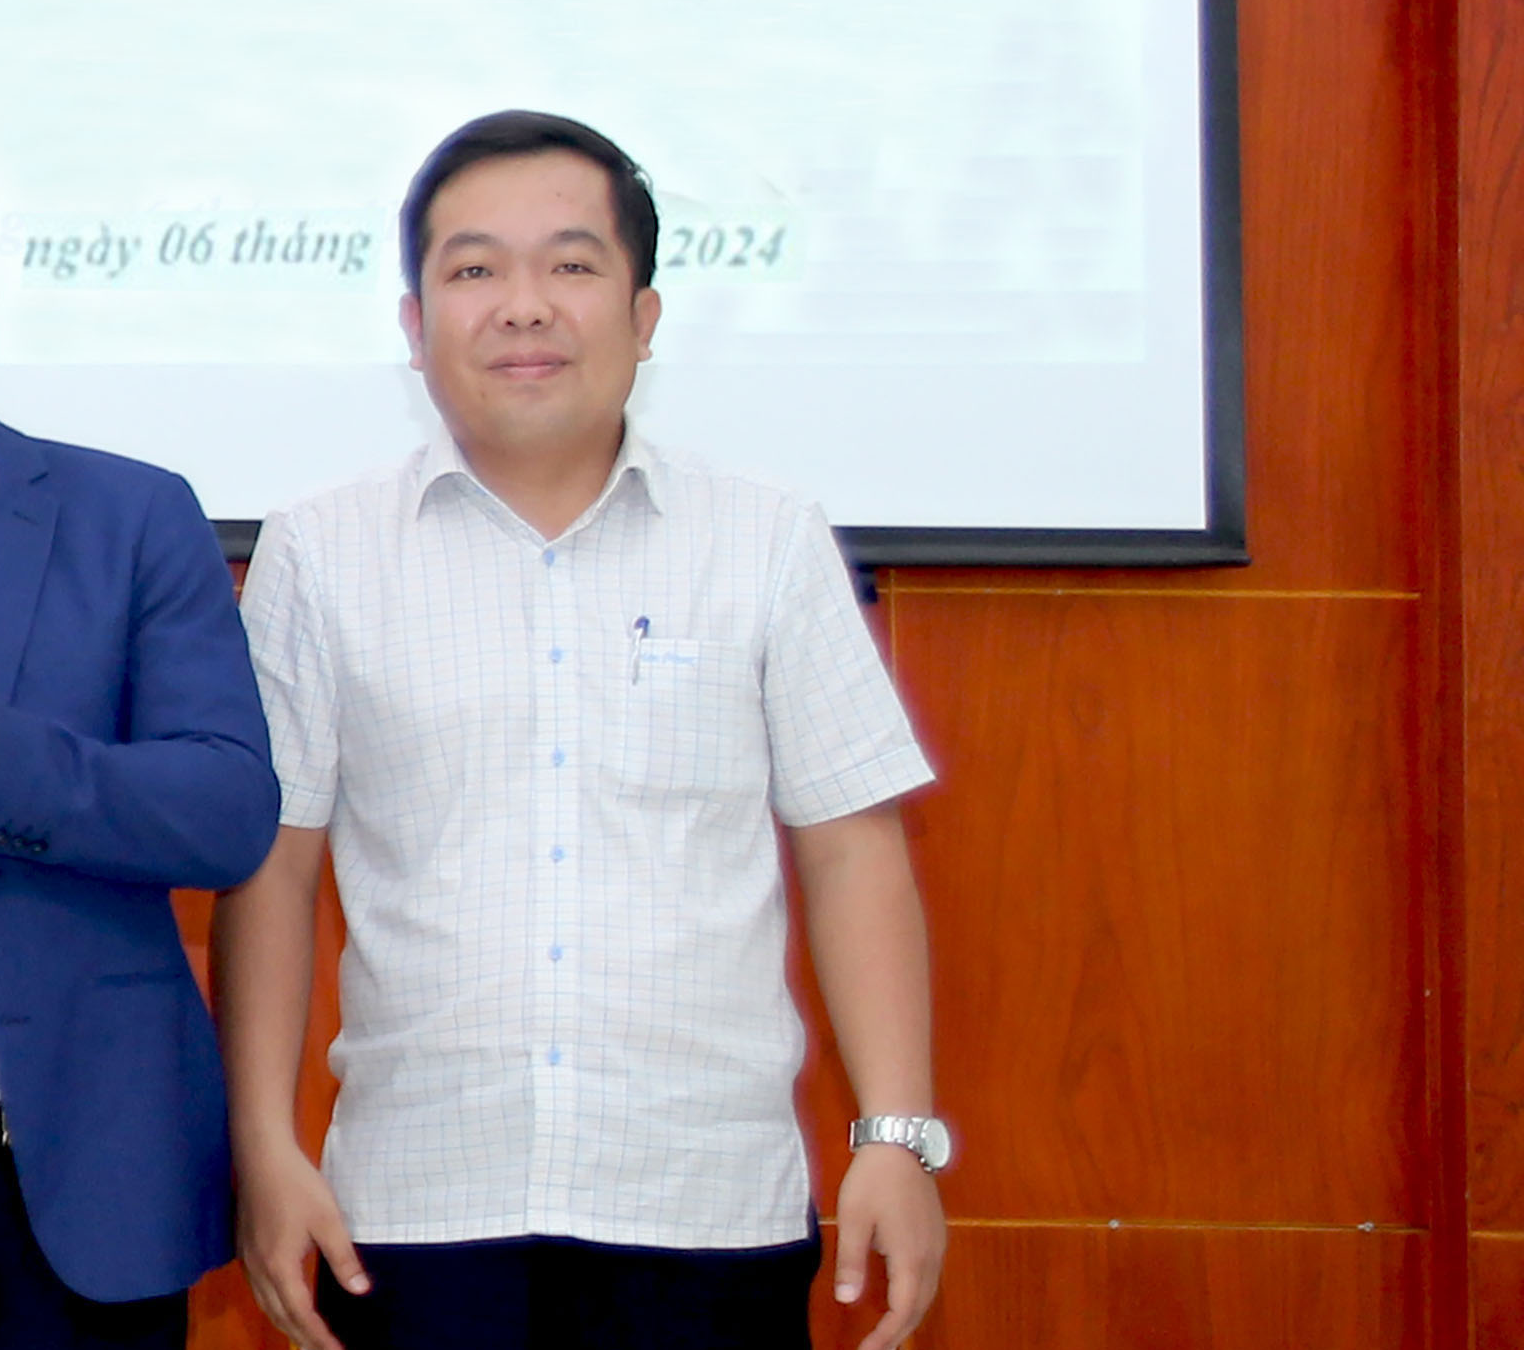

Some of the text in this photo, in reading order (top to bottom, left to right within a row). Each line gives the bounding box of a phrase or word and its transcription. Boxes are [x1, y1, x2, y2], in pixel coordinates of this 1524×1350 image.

[21, 221, 144, 281] ngày
[160, 221, 216, 265] 06
[230, 217, 372, 276] tháng
[665, 226, 788, 268] 2024
